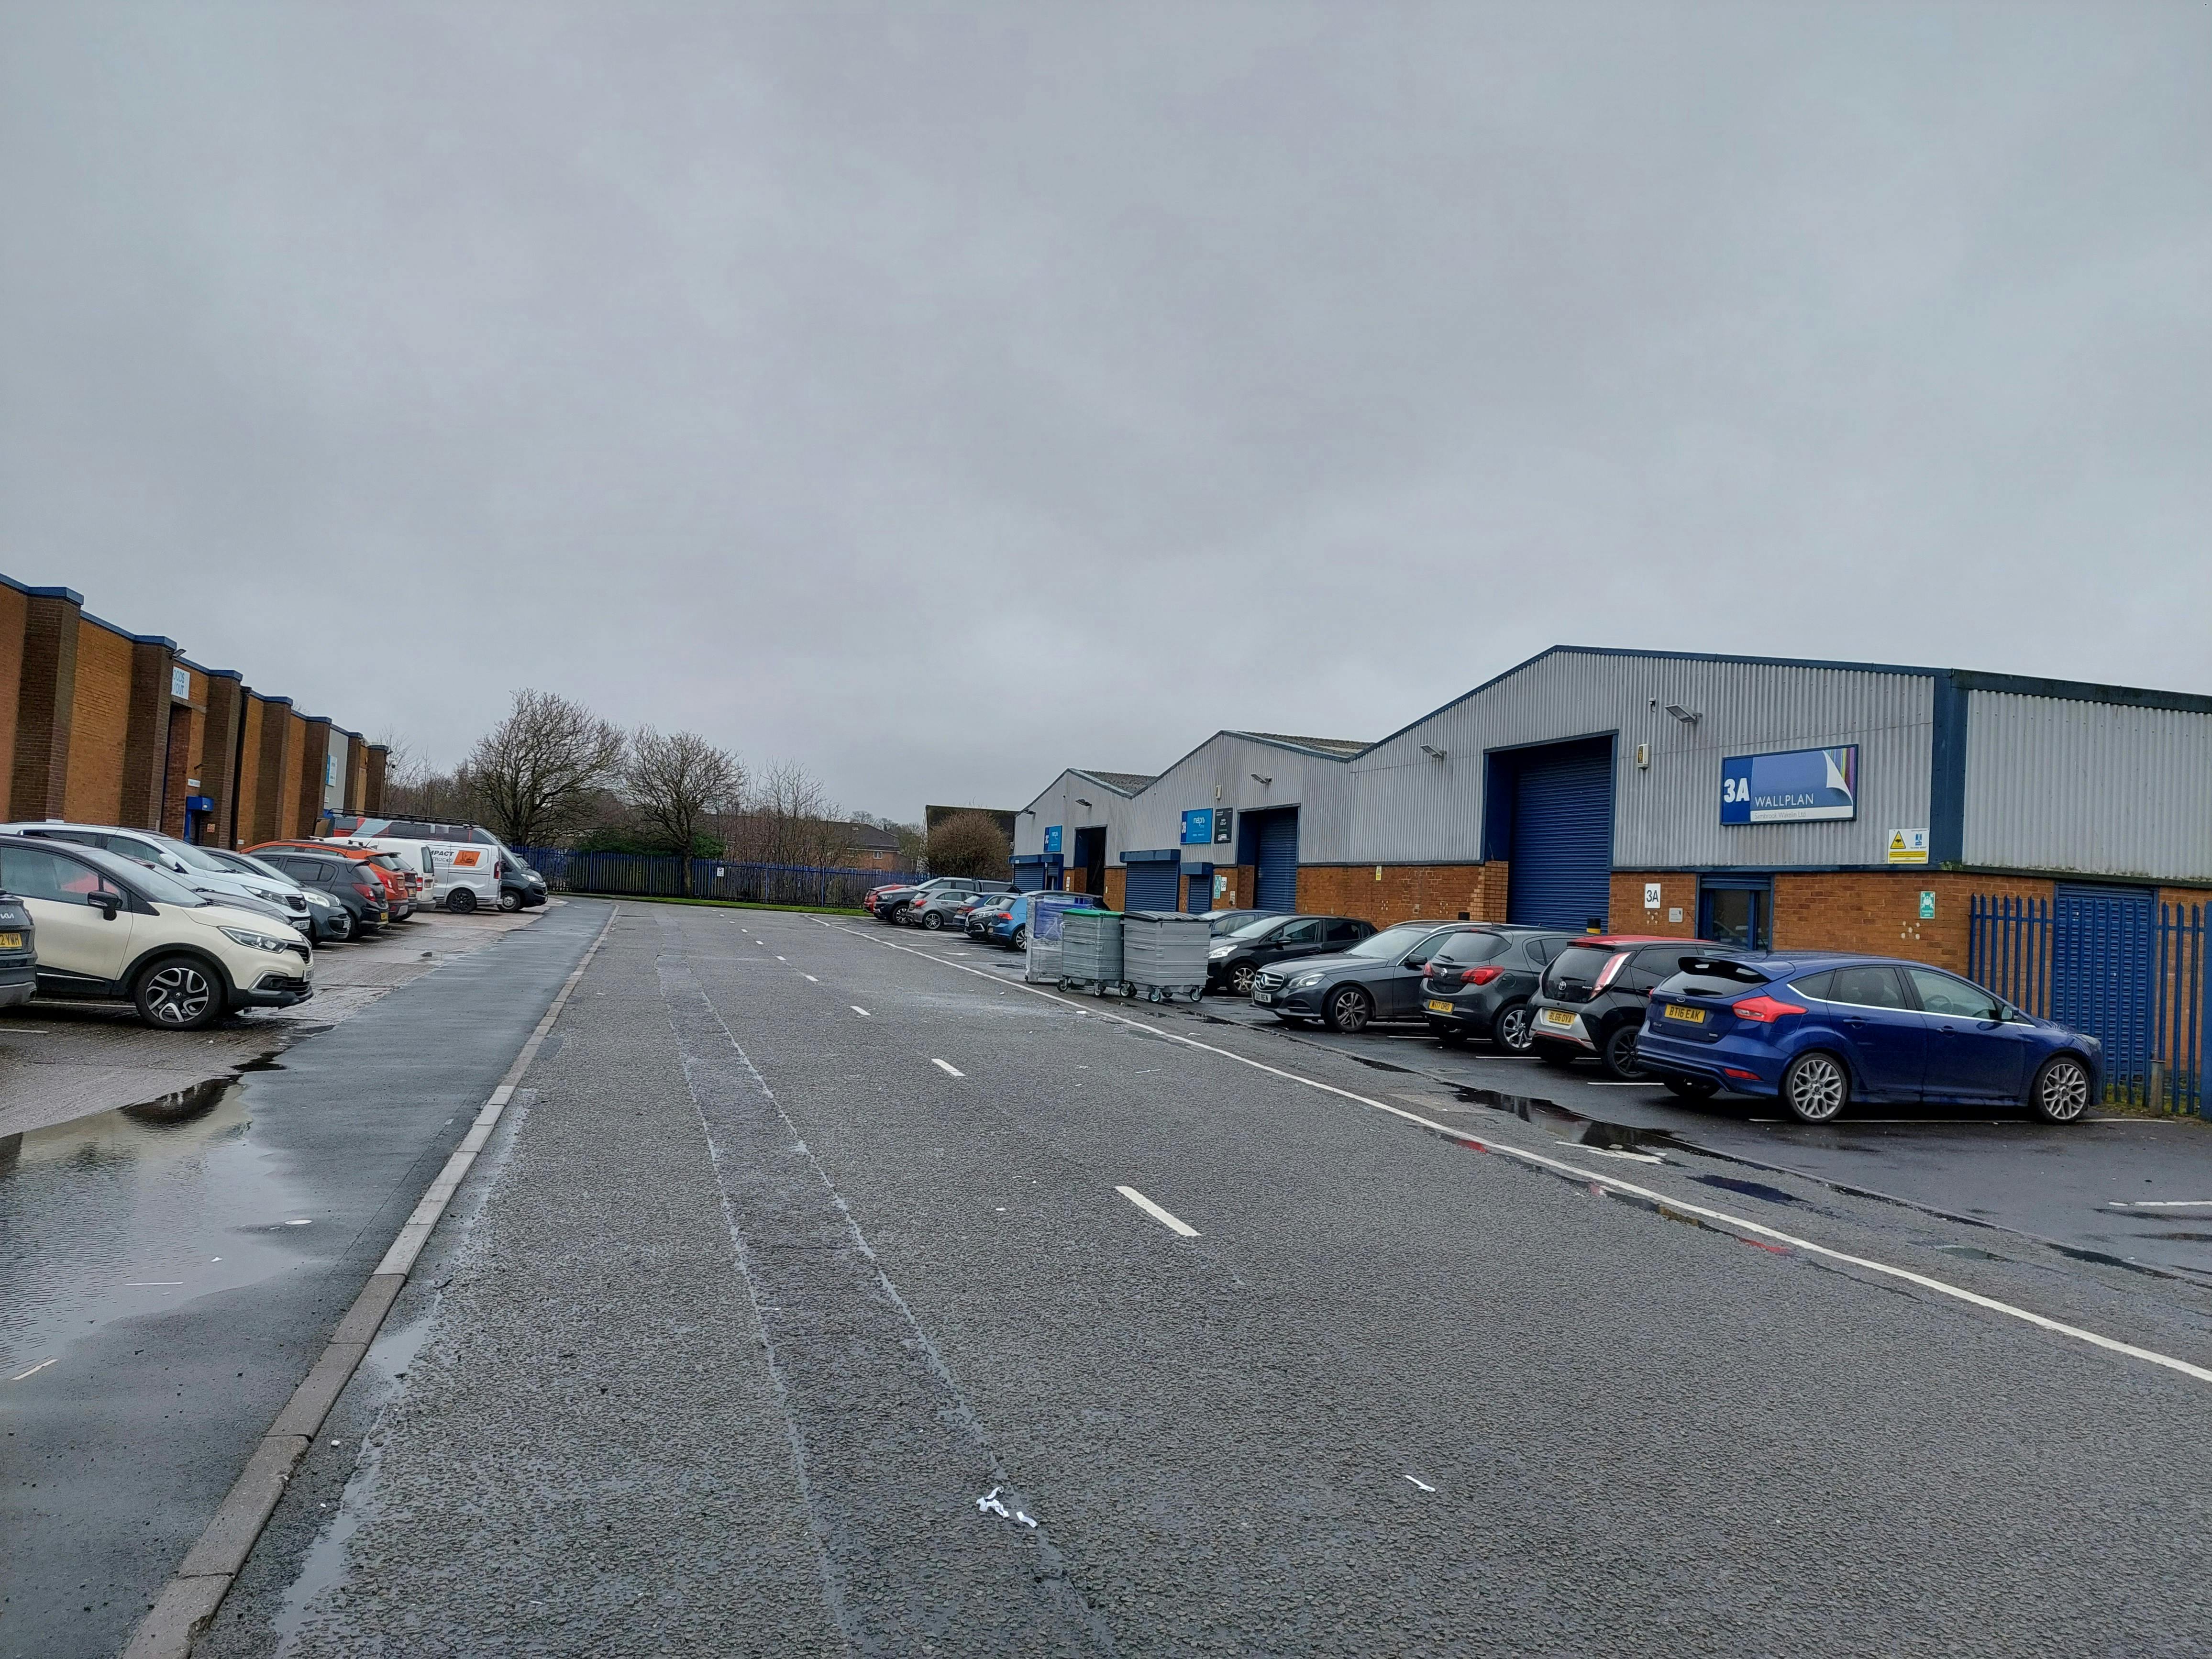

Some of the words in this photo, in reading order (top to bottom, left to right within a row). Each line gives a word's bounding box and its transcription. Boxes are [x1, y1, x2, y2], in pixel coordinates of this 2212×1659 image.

[173, 670, 185, 684] OODS
[1724, 778, 1750, 803] 3A
[1755, 794, 1814, 807] WALLPLAN
[1182, 821, 1186, 833] 3B
[1646, 890, 1659, 903] 3A
[0, 934, 5, 946] 2
[1561, 1014, 1572, 1023] OVA
[1669, 1006, 1685, 1018] BT16
[1685, 1009, 1701, 1020] EAK
